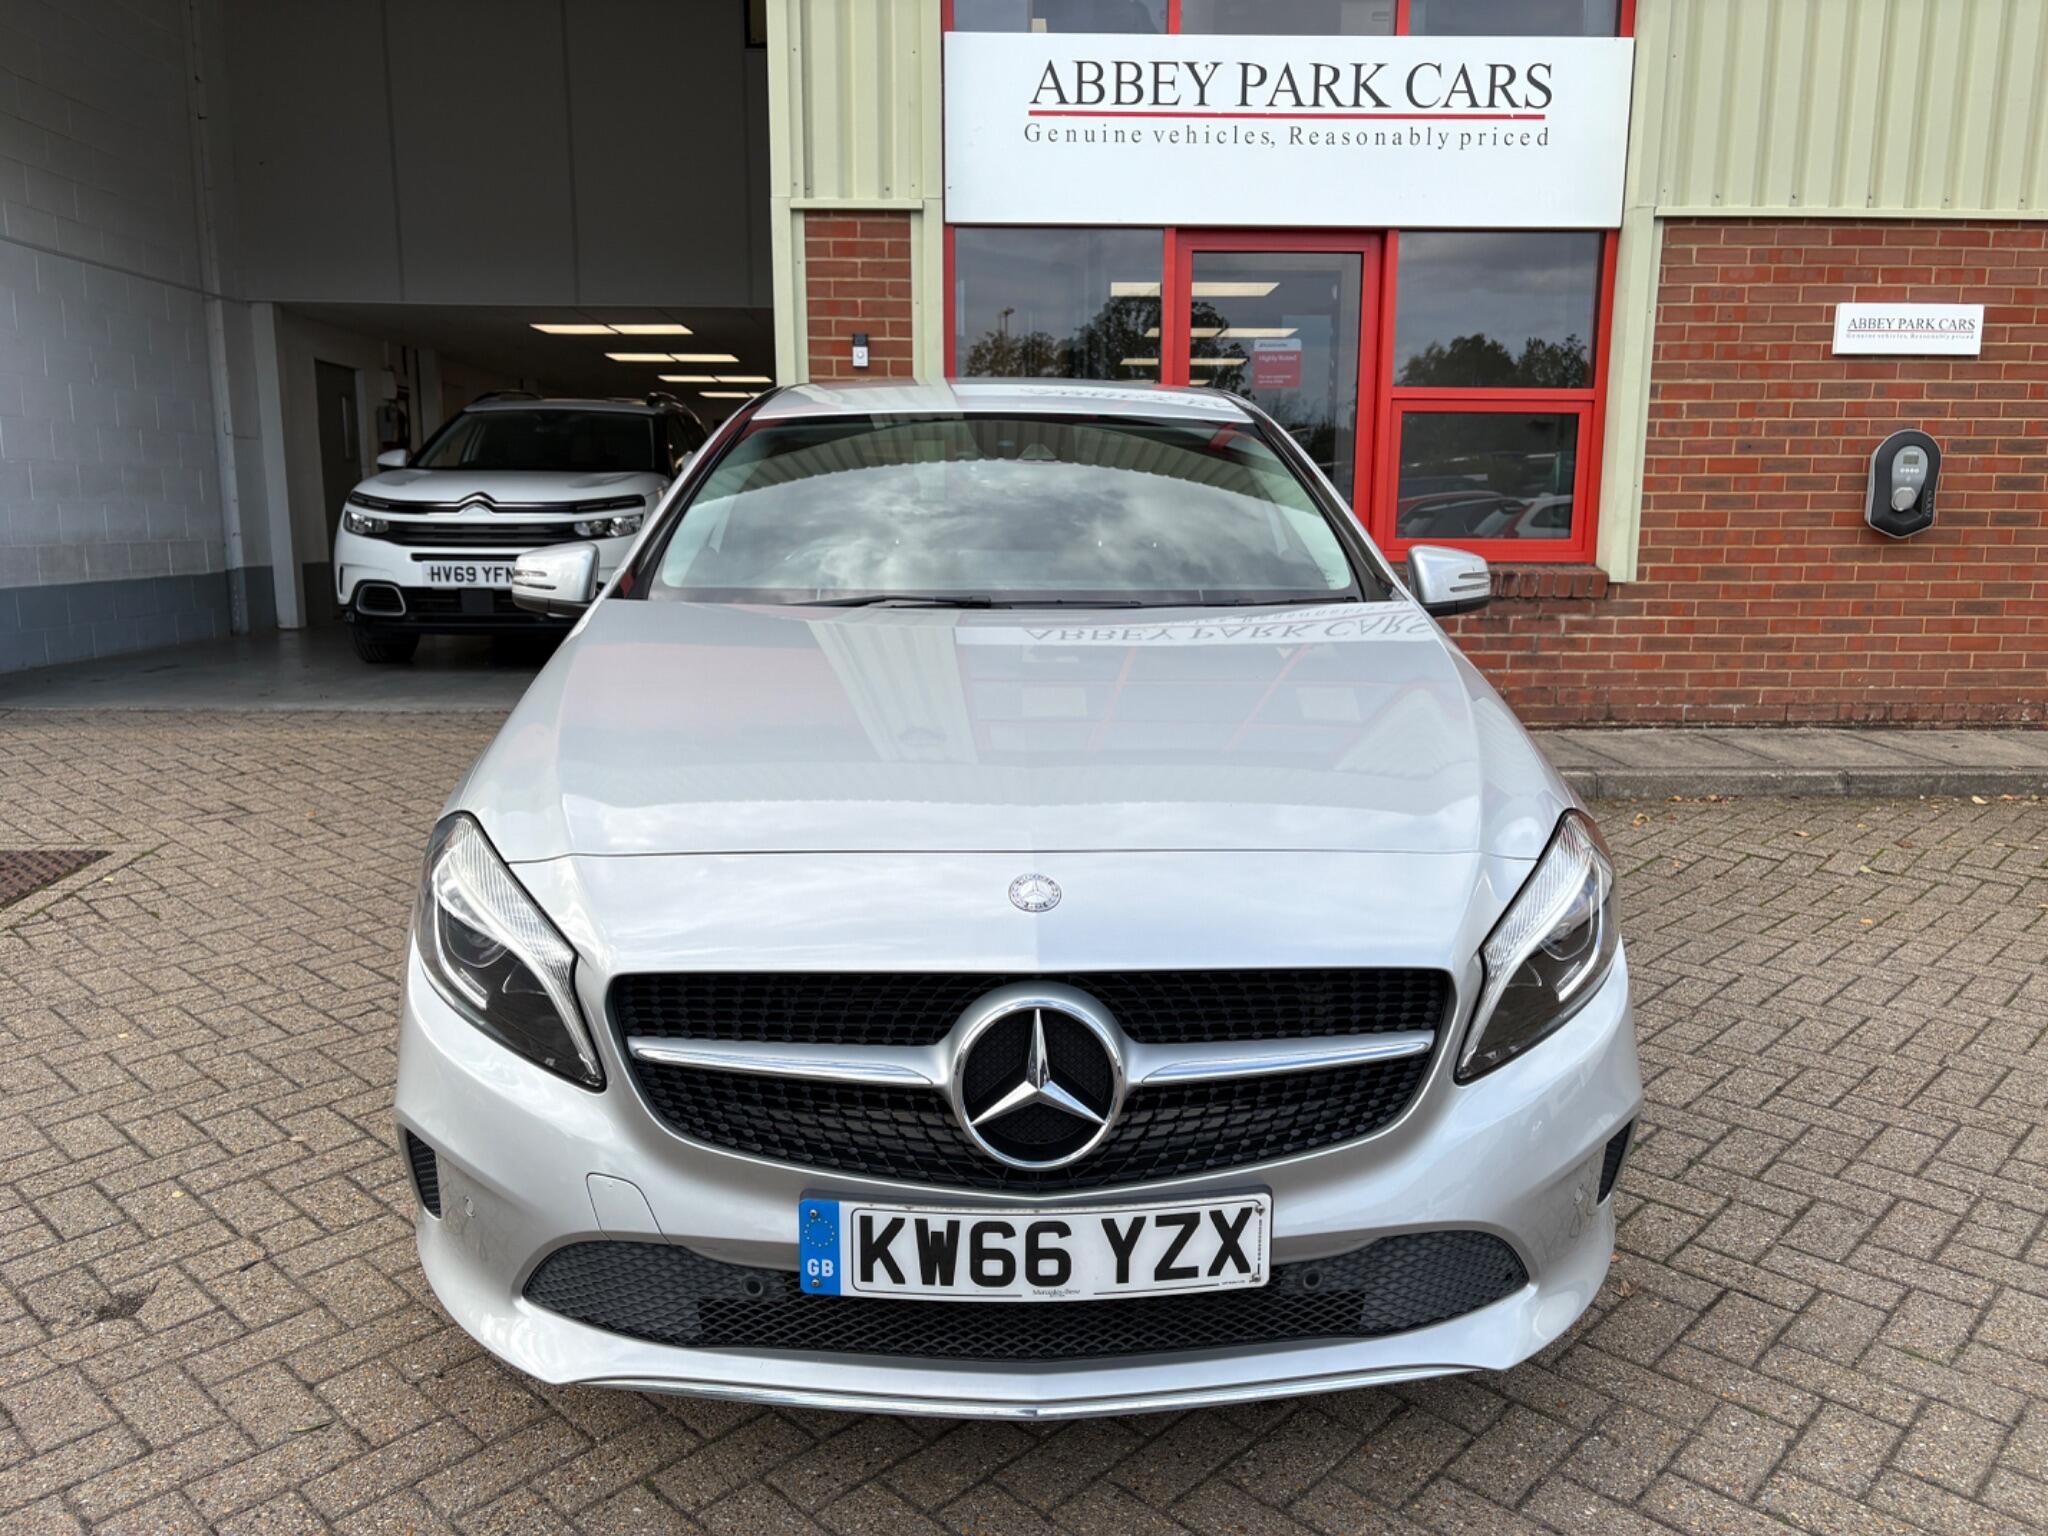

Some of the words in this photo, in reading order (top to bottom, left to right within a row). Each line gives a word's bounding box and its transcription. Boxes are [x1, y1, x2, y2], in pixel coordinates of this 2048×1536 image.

[1030, 60, 1223, 107] ABBEY
[1236, 62, 1391, 108] PARK
[1405, 62, 1553, 109] CARS
[1024, 123, 1142, 144] Genuine
[1152, 124, 1277, 148] vehicles,
[1289, 125, 1451, 150] Reasonably
[1459, 126, 1549, 151] priced
[1847, 317, 1895, 329] ABBEY
[1897, 318, 1935, 330] PARK
[1938, 318, 1976, 331] CARS
[430, 566, 477, 583] HV69
[859, 1215, 1072, 1288] KW66
[1100, 1206, 1253, 1285] YZX
[806, 1258, 834, 1278] GB
